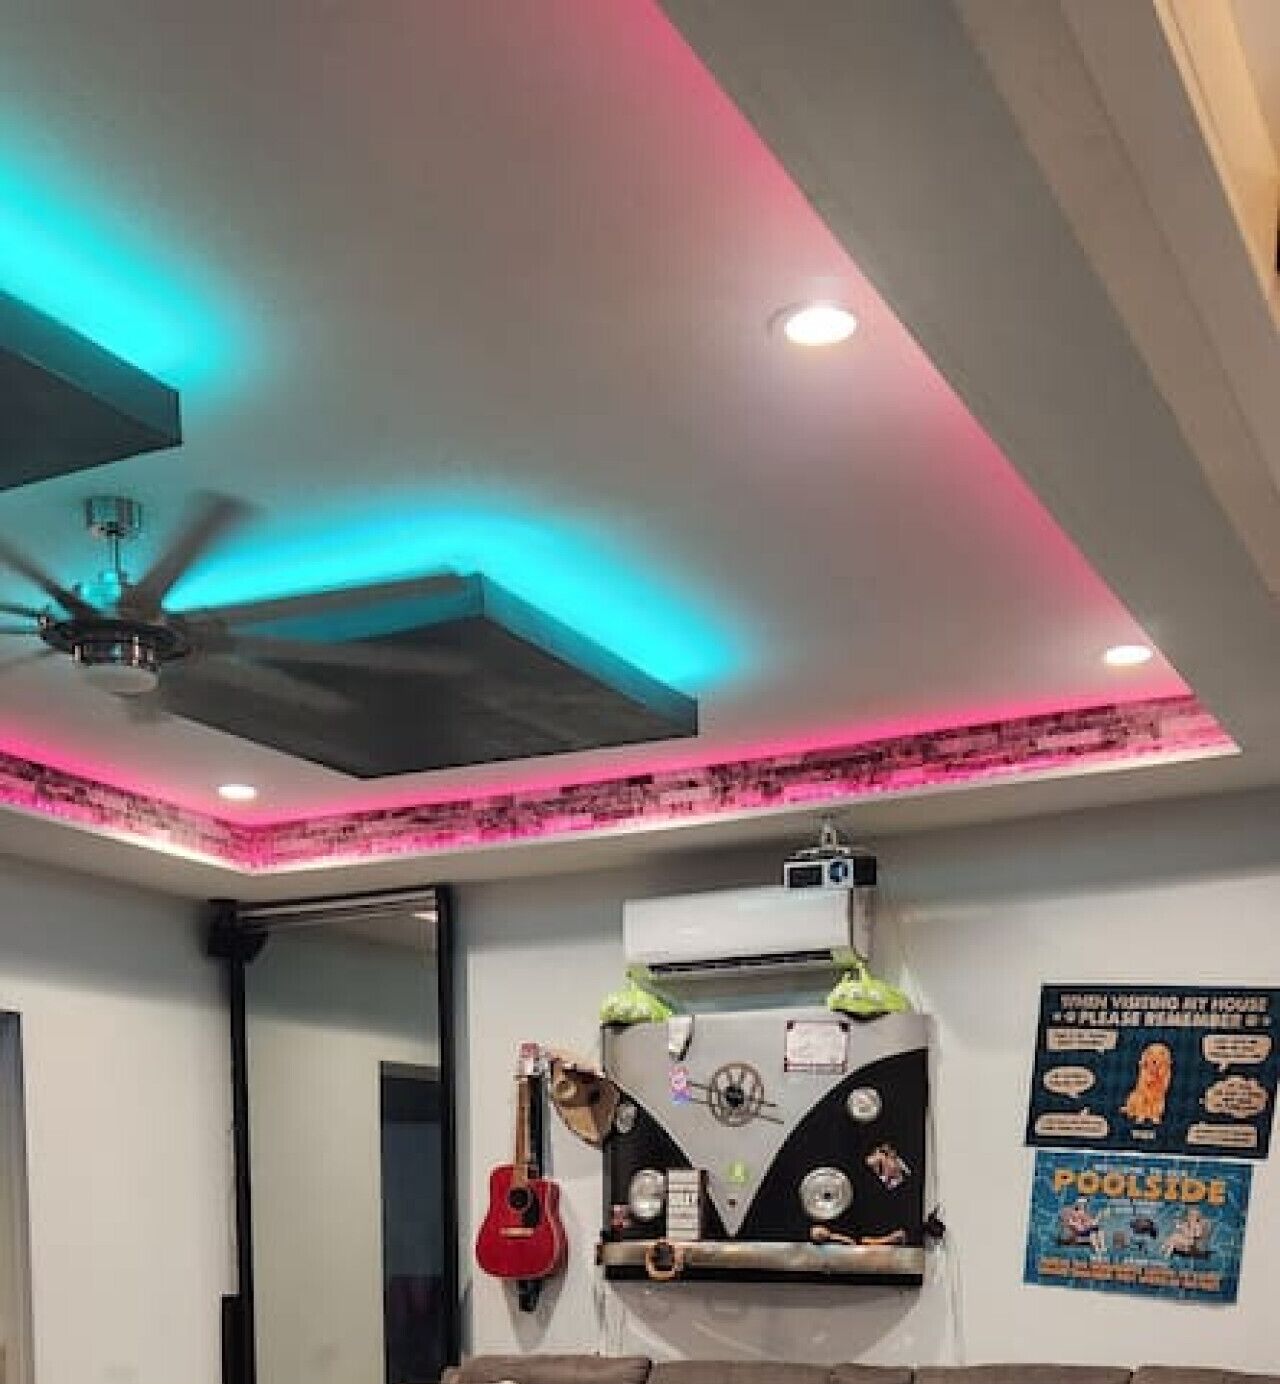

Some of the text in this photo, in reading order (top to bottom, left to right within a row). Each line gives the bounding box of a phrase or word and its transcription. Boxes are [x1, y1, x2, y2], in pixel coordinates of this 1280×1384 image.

[1060, 993, 1108, 1010] WHEN
[1112, 993, 1180, 1011] VISITING
[1210, 996, 1269, 1013] HOUSE
[1078, 1010, 1243, 1028] PLEASE REMEMBER
[1053, 1168, 1227, 1206] POOLSIDE
